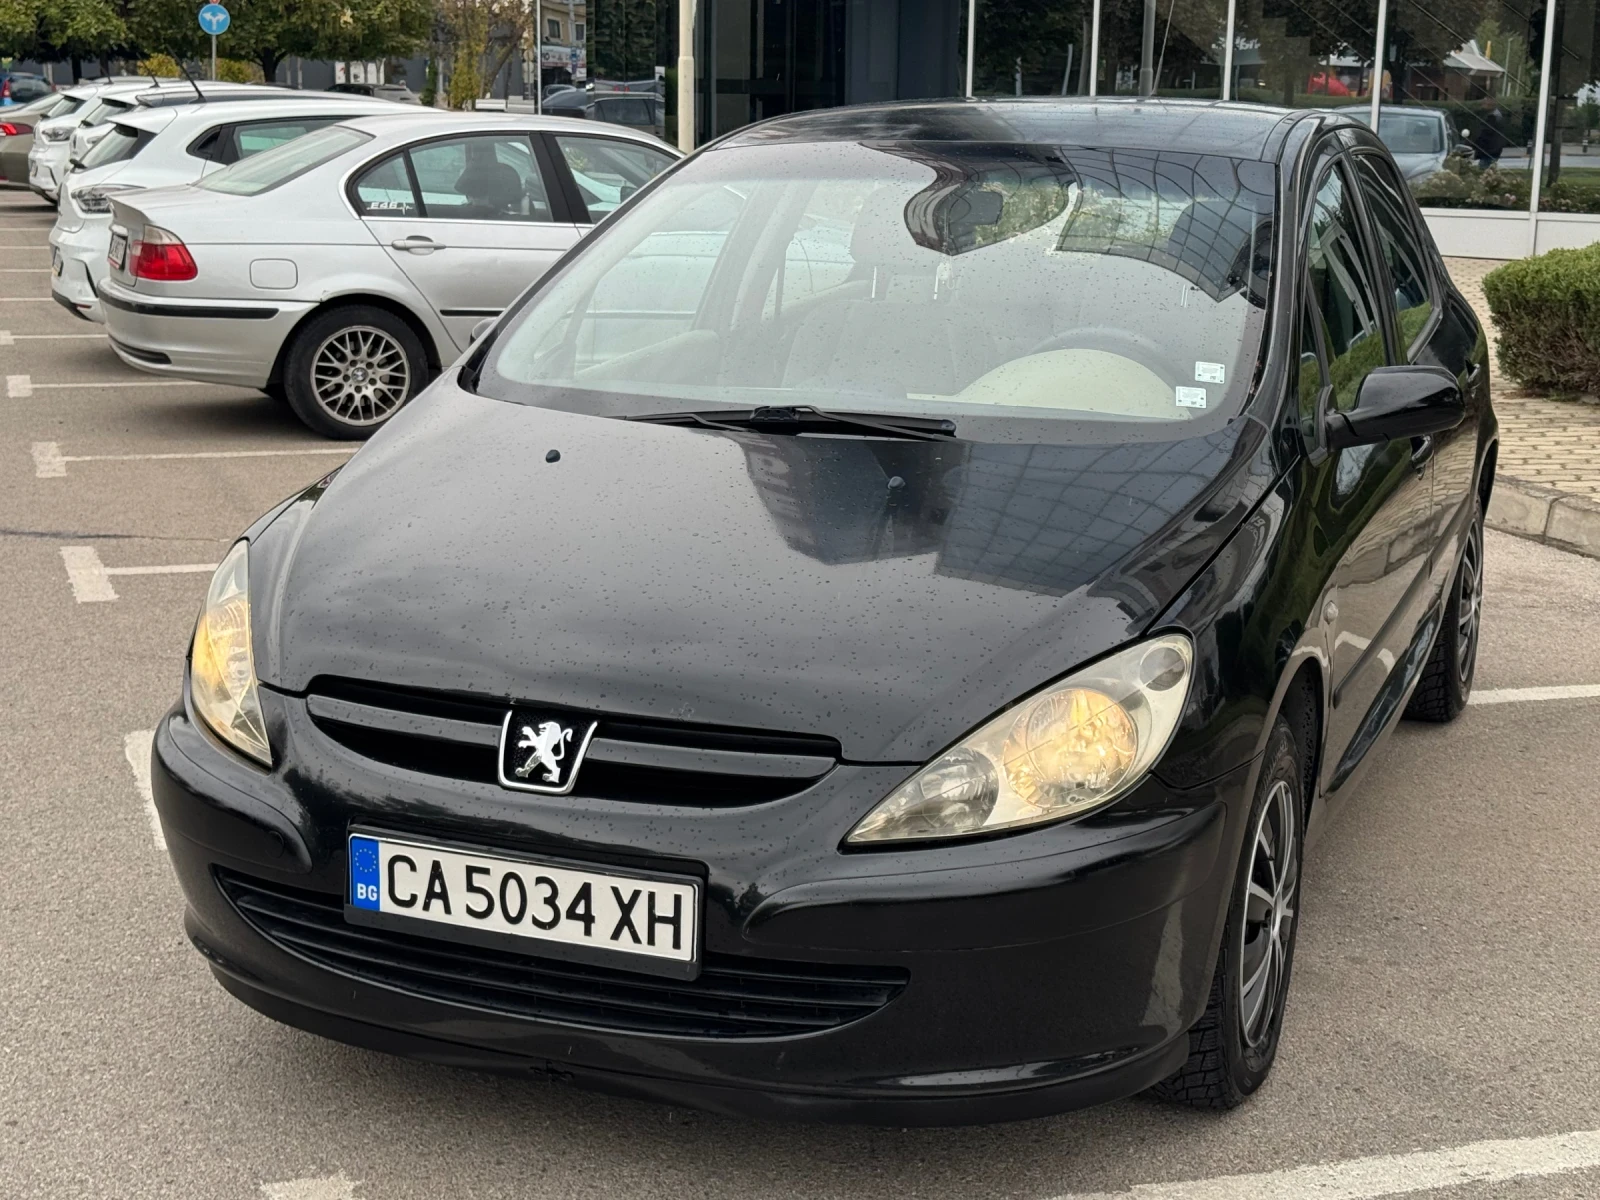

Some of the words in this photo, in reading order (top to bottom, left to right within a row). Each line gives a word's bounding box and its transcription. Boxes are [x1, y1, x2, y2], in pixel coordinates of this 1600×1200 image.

[357, 882, 378, 902] BG
[387, 854, 452, 915] CA
[465, 864, 596, 937] 5034
[609, 885, 683, 950] XH
